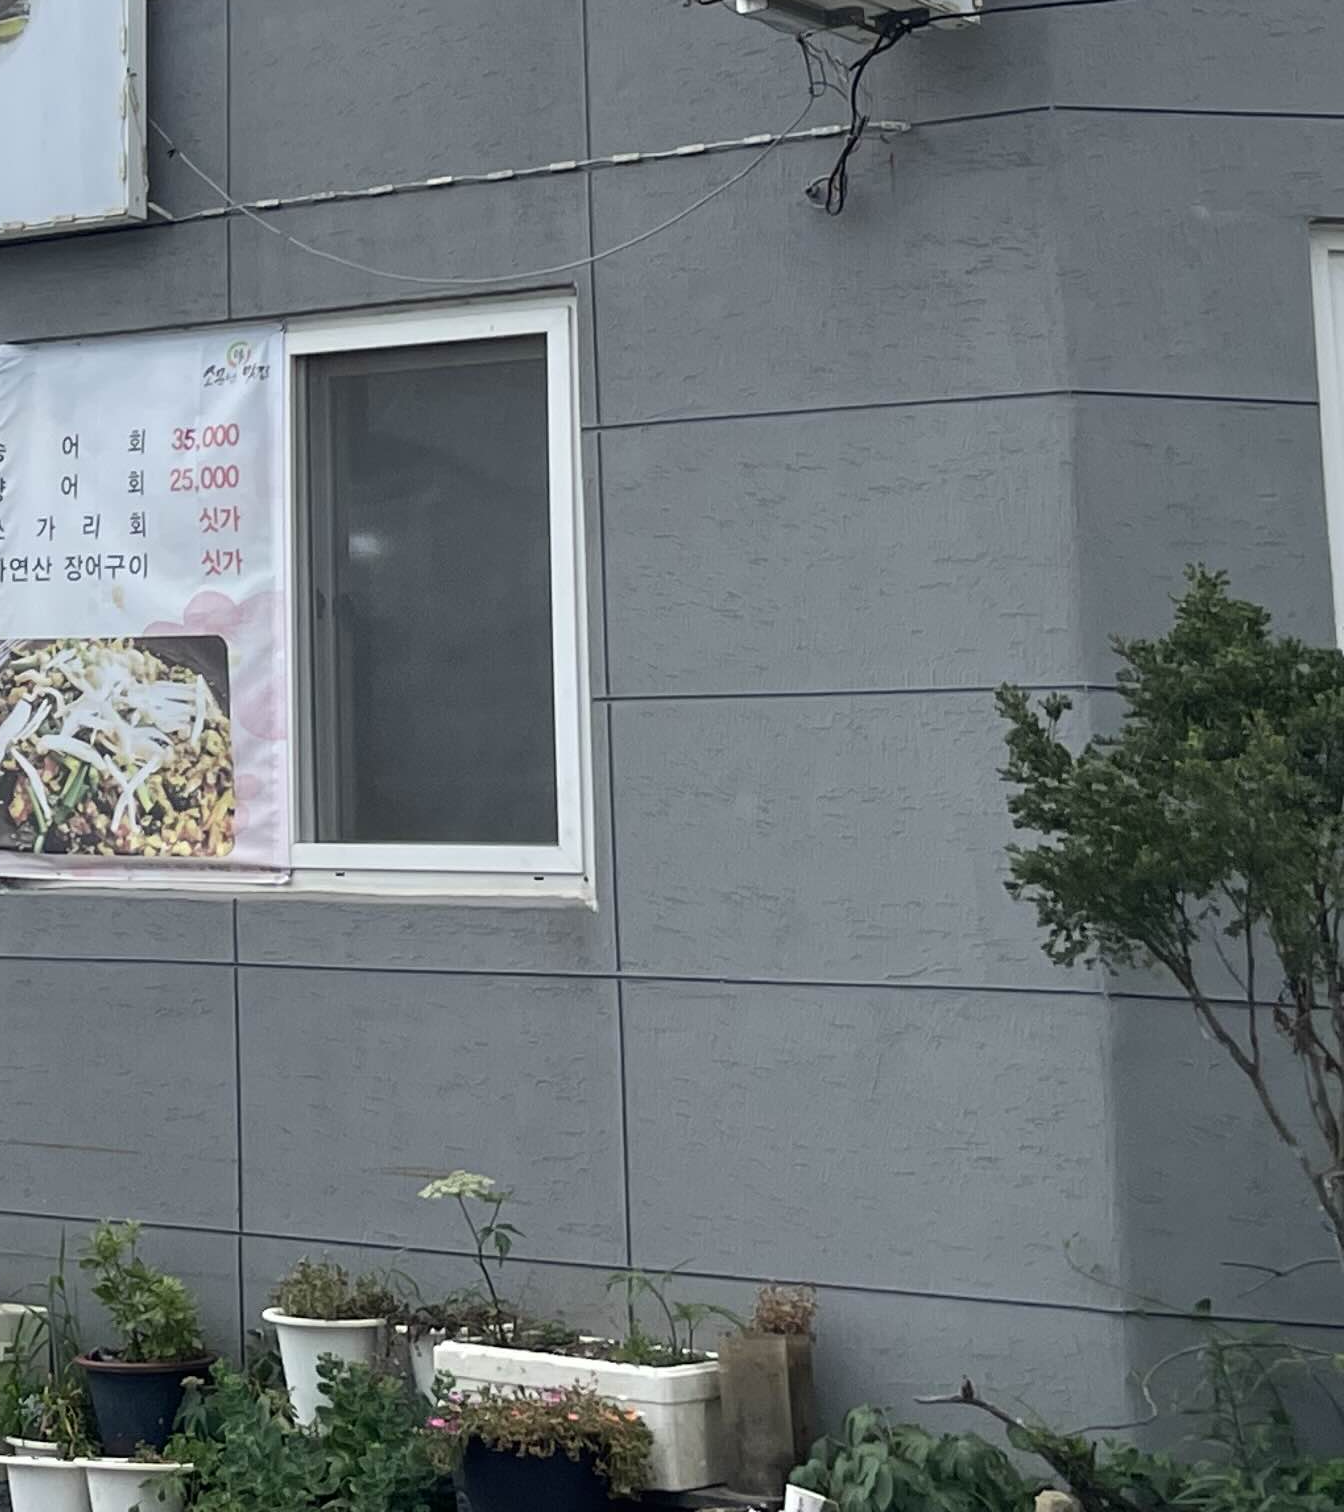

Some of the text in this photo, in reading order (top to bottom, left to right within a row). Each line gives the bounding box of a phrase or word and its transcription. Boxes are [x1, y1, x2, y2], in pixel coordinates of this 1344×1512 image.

[171, 423, 240, 452] 35,000
[170, 464, 240, 494] 25,000
[199, 505, 241, 533] 싯가
[63, 552, 149, 583] 장어구이
[201, 548, 243, 576] 싯가
